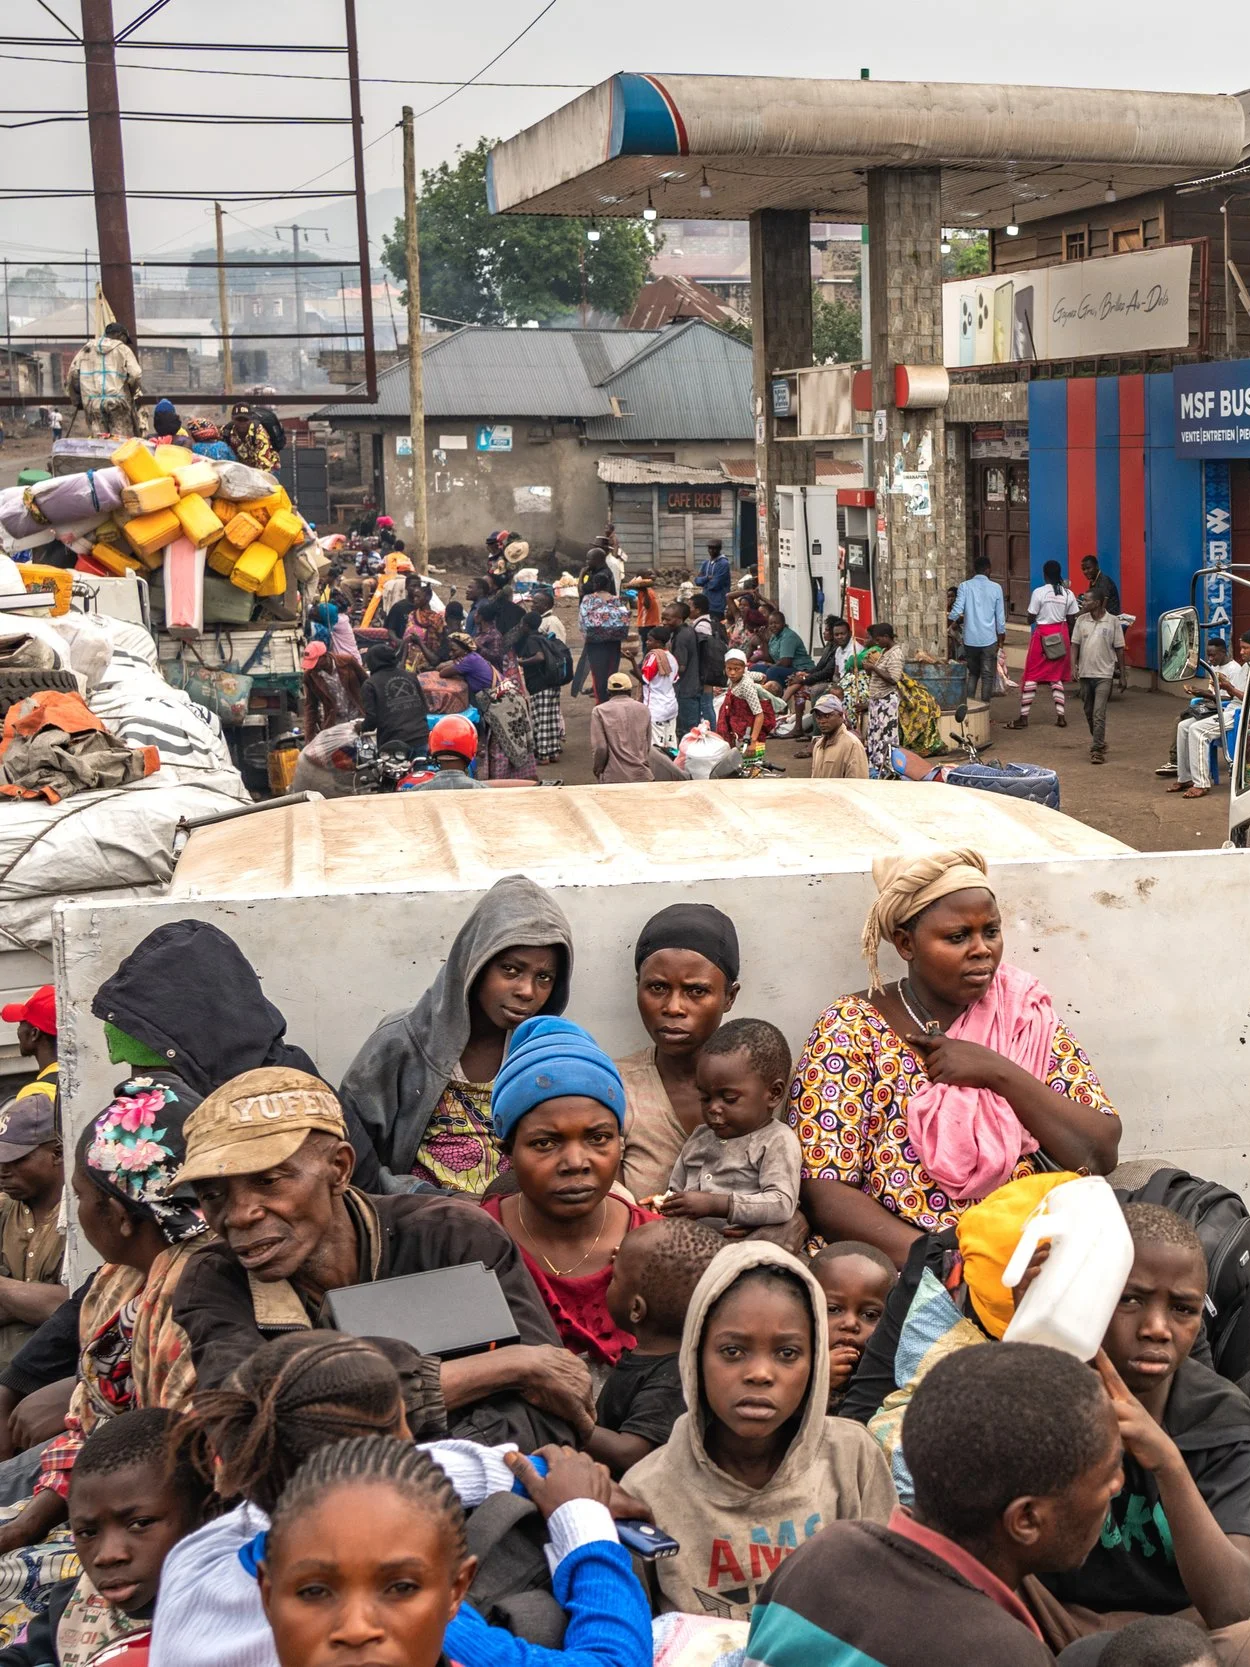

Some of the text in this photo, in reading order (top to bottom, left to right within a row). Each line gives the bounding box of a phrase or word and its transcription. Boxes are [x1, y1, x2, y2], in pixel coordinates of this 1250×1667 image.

[1180, 391, 1215, 419] MSF
[1181, 430, 1200, 442] VENTE
[1202, 429, 1235, 442] ENTRETIEN
[668, 492, 721, 508] CAFE RESTO
